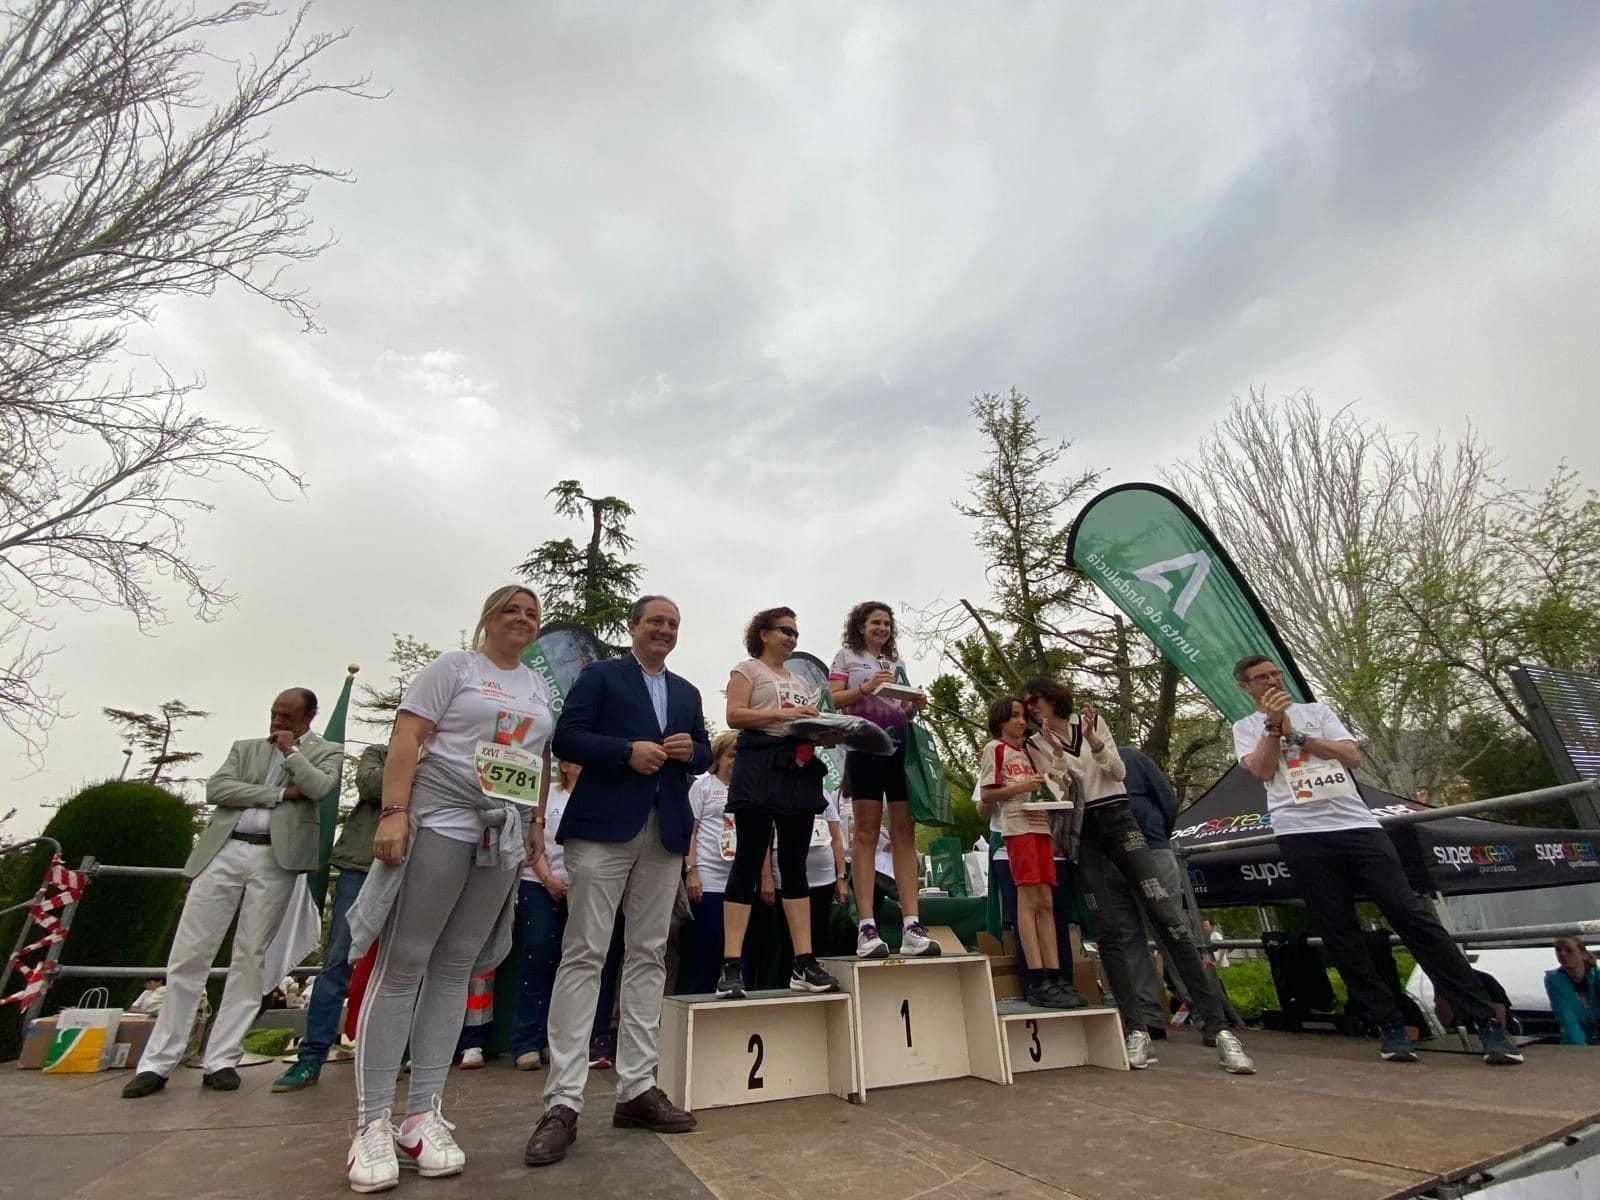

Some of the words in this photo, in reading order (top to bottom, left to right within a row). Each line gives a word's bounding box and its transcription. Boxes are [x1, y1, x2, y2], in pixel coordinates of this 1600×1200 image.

[489, 765, 537, 790] 5781
[1304, 772, 1346, 789] 1448
[1240, 861, 1291, 886] supe
[899, 998, 913, 1048] 1
[1024, 1018, 1042, 1062] 3
[746, 1033, 764, 1090] 2
